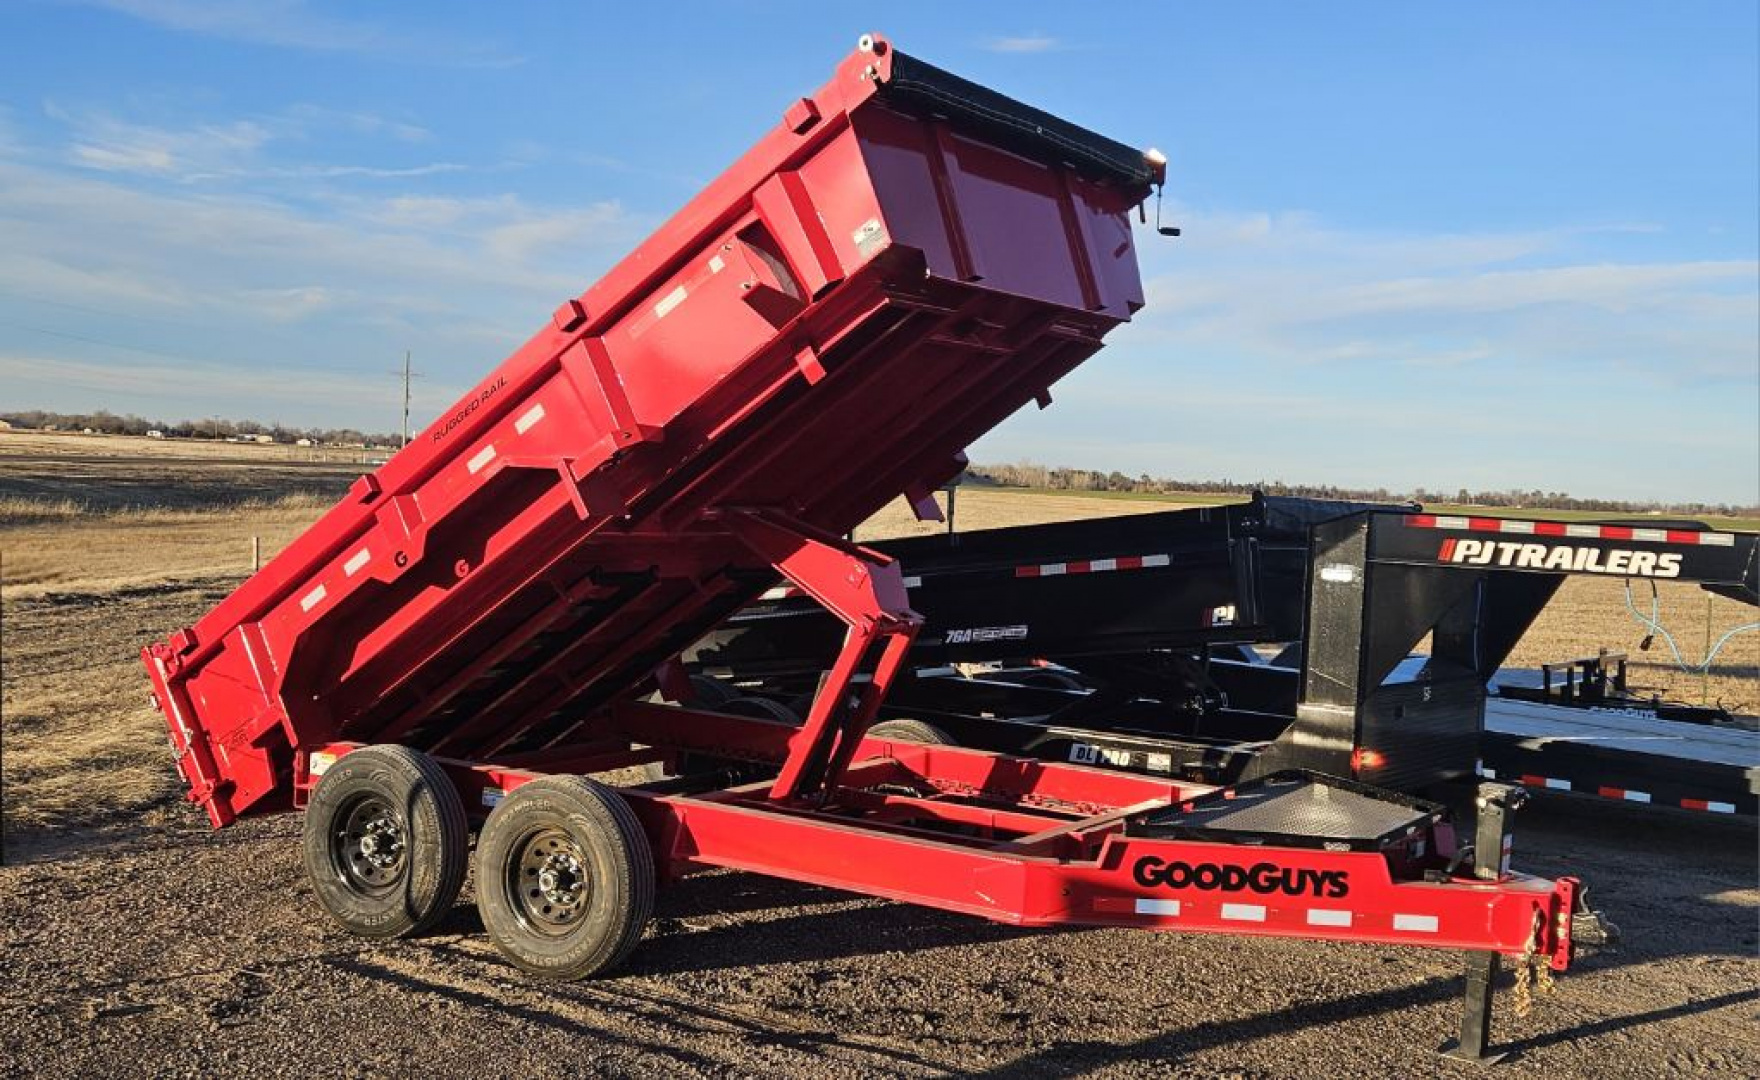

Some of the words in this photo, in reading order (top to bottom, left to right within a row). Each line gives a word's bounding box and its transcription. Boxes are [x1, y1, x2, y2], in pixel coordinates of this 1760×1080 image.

[432, 399, 479, 444] RUGGED
[481, 376, 507, 403] RAIL
[394, 550, 408, 568] G
[455, 559, 469, 578] G
[1452, 539, 1496, 565] PJ
[1498, 543, 1684, 578] TRAILERS
[1133, 855, 1349, 898] GOODGUYS
